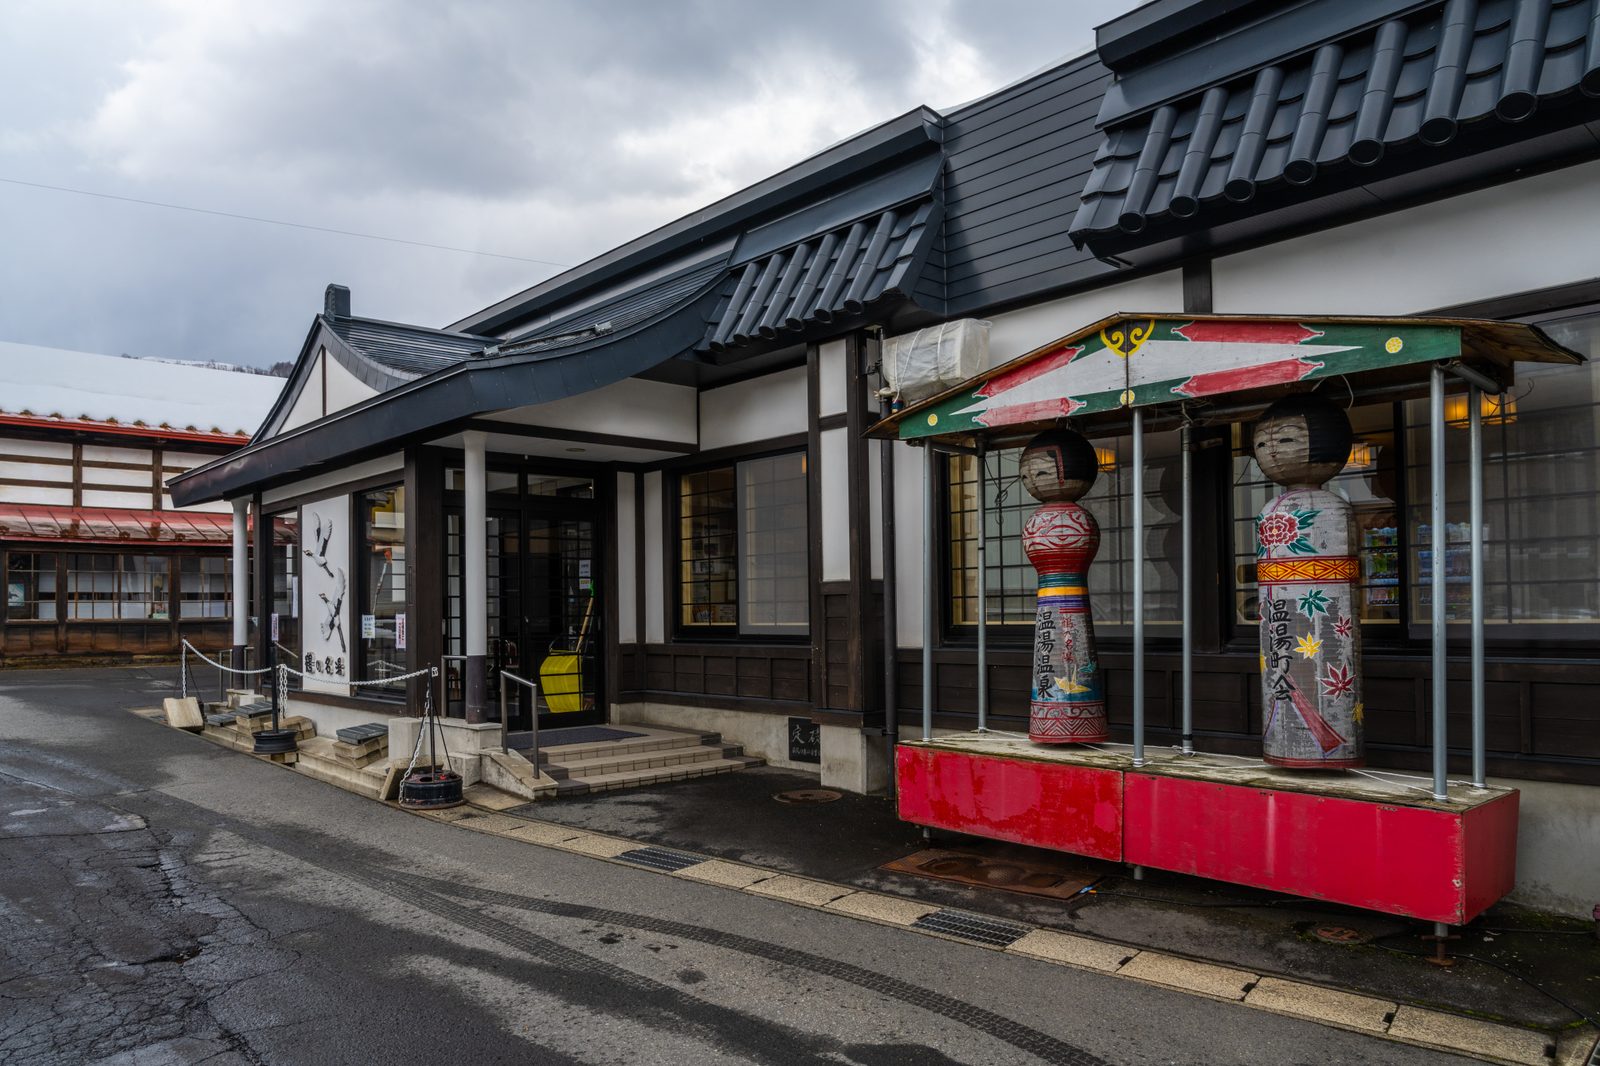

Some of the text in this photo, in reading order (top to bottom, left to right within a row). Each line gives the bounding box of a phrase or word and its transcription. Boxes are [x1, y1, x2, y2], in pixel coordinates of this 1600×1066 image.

[1037, 610, 1056, 699] 温湯温泉
[1268, 598, 1297, 702] 温湯町会
